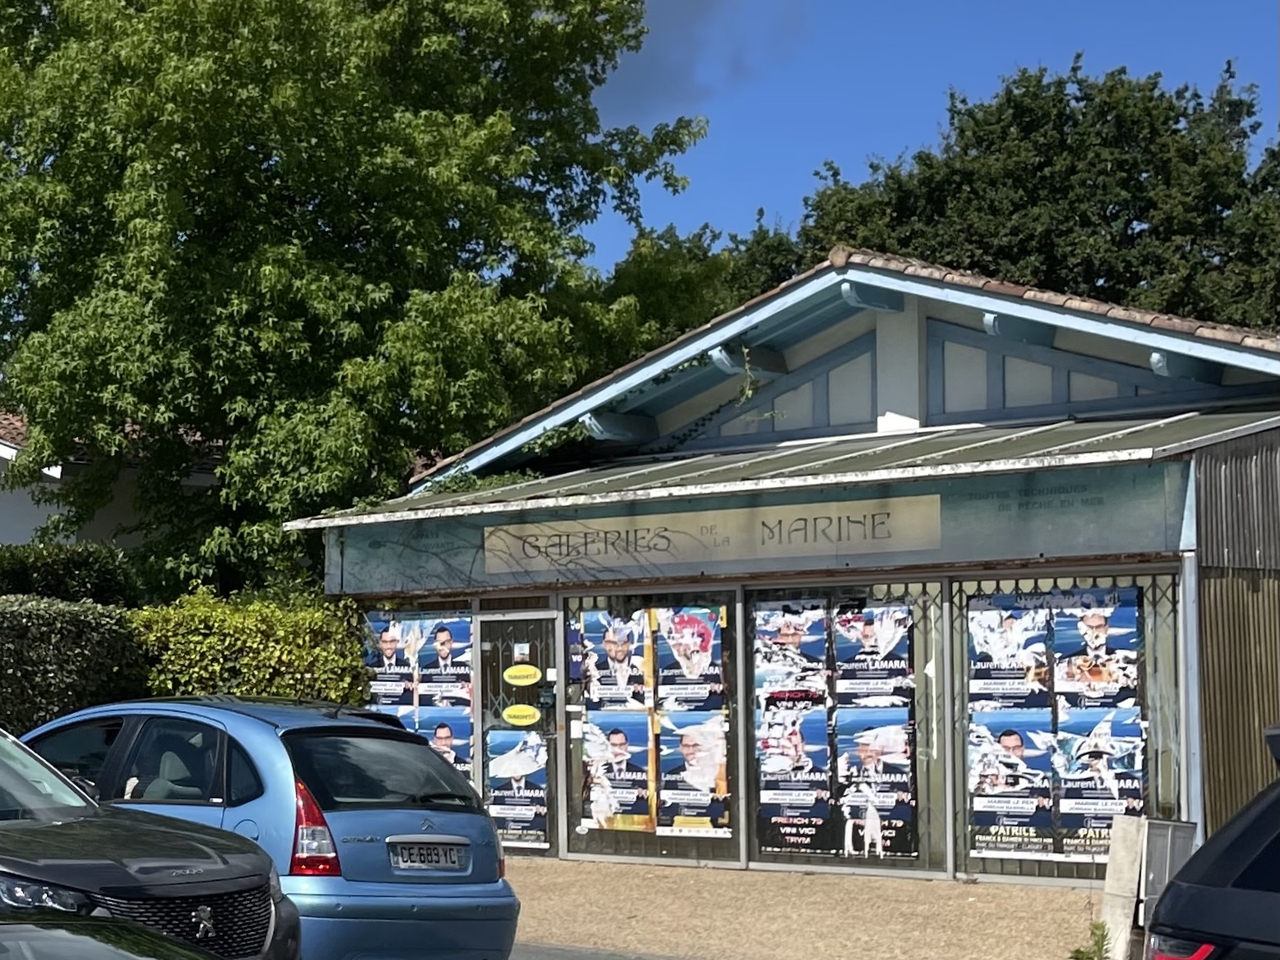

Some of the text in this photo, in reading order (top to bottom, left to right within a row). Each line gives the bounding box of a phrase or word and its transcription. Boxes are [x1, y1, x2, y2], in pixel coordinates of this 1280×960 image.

[1018, 484, 1088, 498] TECHNIQUES
[1060, 499, 1074, 508] EN
[522, 512, 892, 558] GALERIES DE LA MARINE
[869, 660, 907, 670] LAMARA
[386, 666, 413, 674] LAMARA
[442, 666, 470, 674] LAMARA
[616, 772, 647, 780] LAMARA
[791, 772, 826, 780] LAMARA
[1061, 780, 1095, 788] Laurent
[490, 788, 544, 798] Laurent LAMARA
[798, 827, 816, 835] VICI
[989, 825, 1036, 836] PATRICE
[400, 845, 456, 865] CE-689-YC
